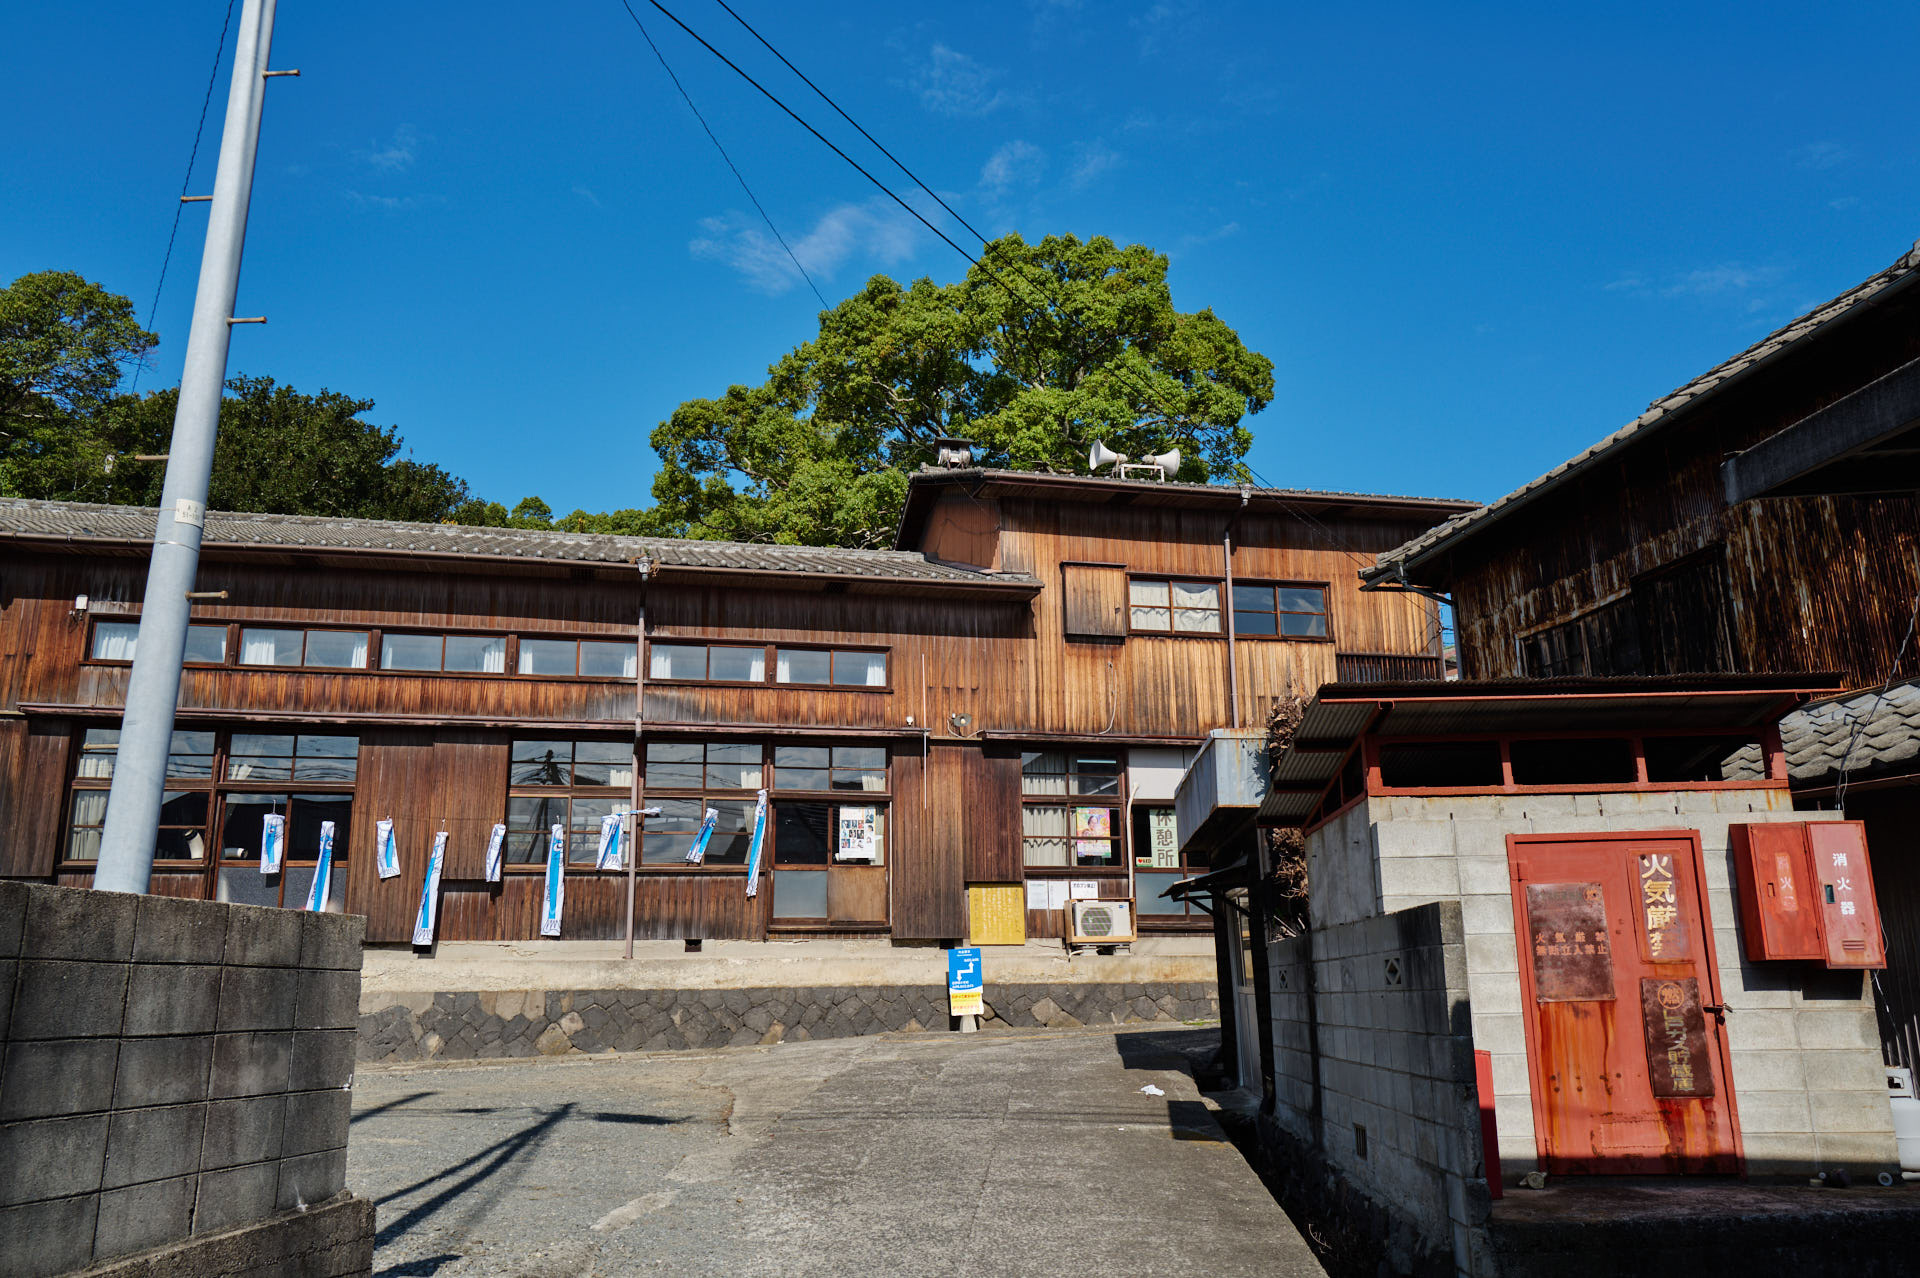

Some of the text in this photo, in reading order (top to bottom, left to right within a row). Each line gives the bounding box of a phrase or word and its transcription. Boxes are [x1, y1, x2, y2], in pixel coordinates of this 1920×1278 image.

[1156, 809, 1174, 867] 休憩所
[1832, 853, 1856, 915] 消火器
[1536, 944, 1608, 956] 無断立入禁止
